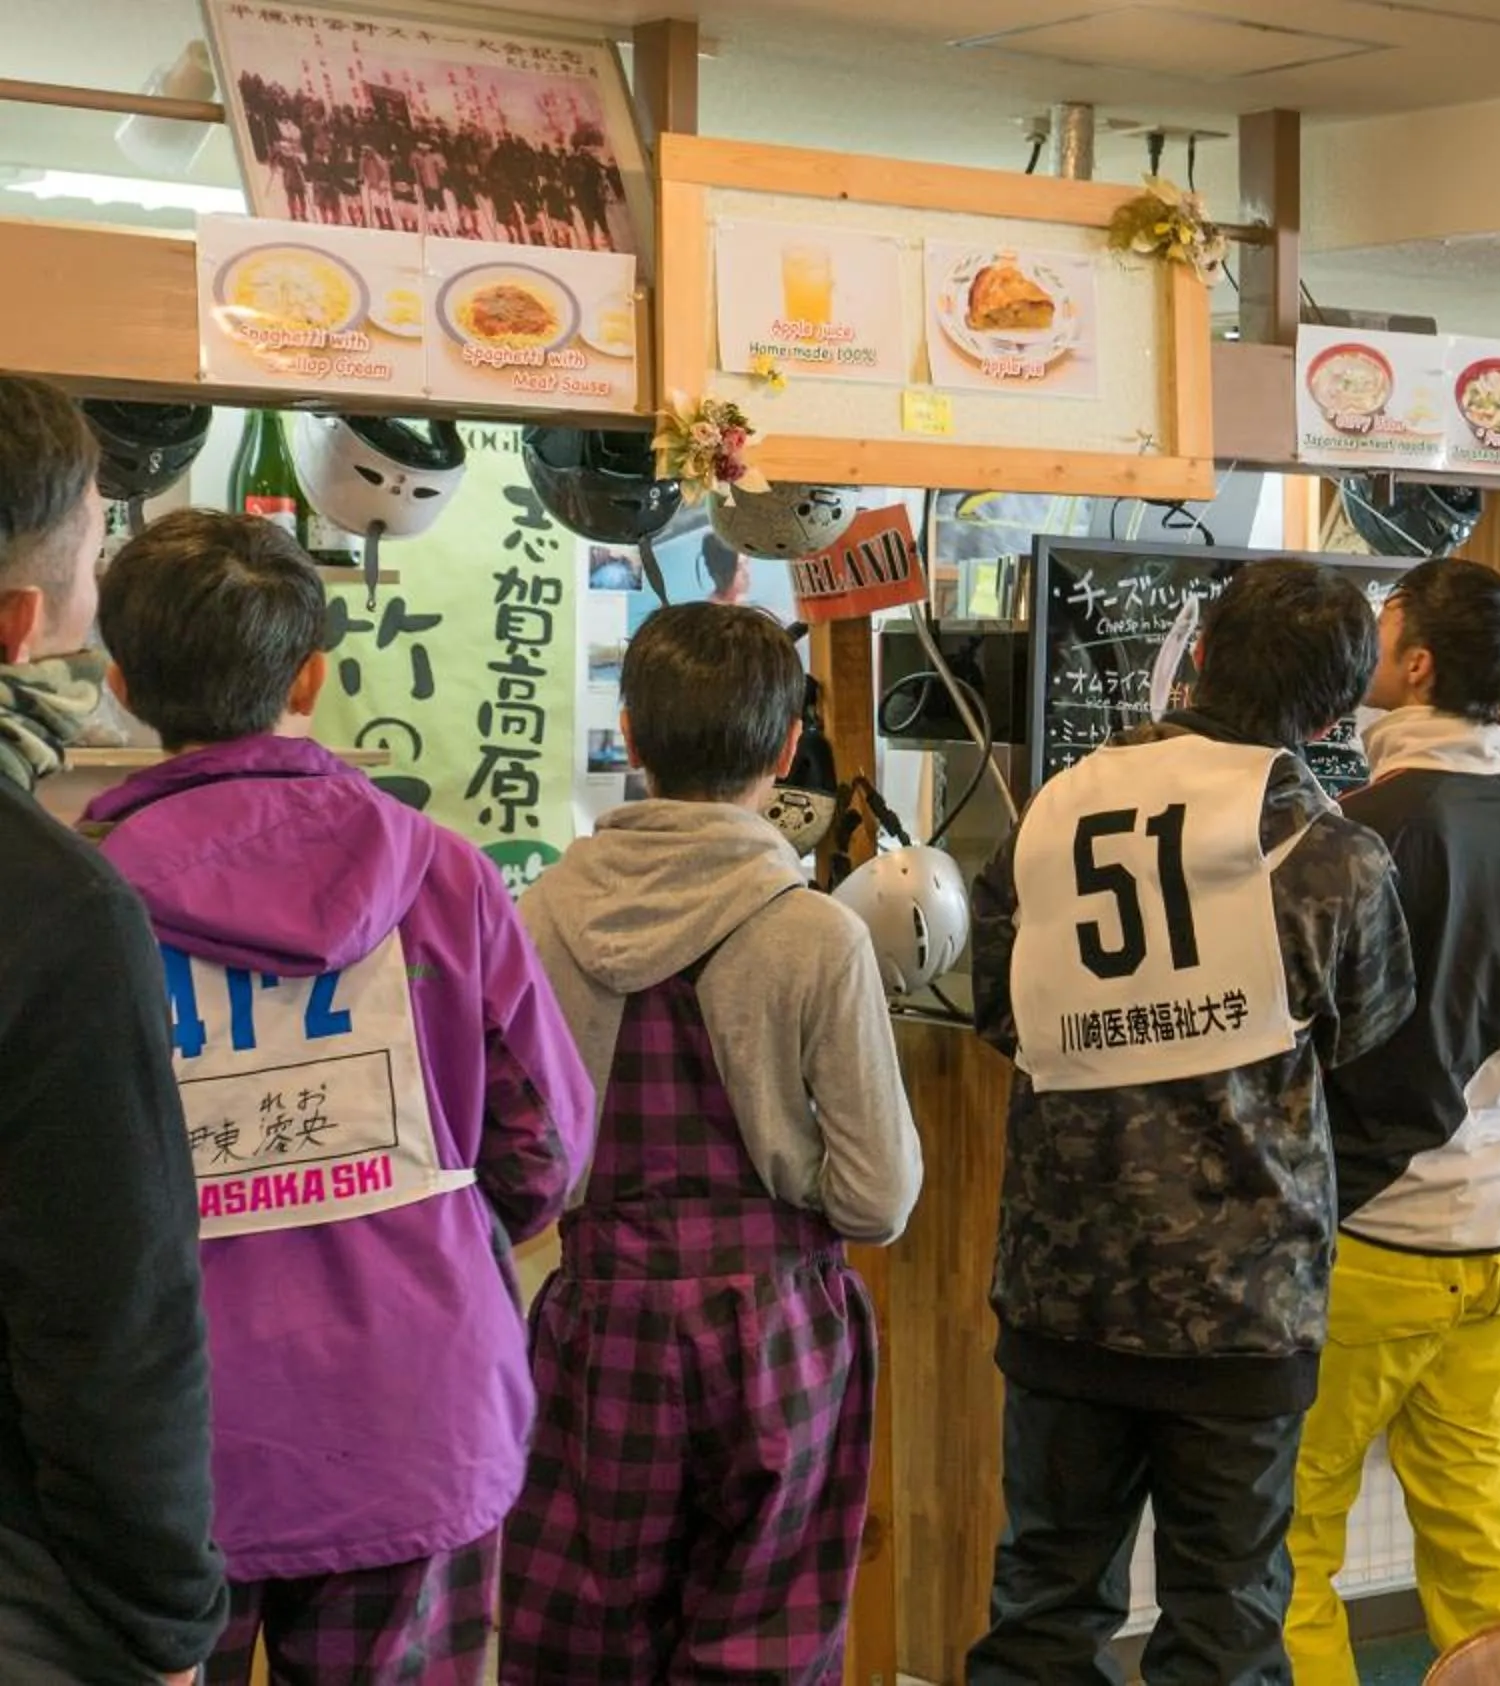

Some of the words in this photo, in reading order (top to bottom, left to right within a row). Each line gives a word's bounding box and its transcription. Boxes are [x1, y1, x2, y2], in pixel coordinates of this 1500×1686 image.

[329, 331, 370, 350] with
[770, 319, 813, 341] Apple
[333, 358, 390, 379] Cream
[463, 342, 545, 368] Spaghetti
[547, 349, 587, 369] with
[982, 358, 1021, 378] Apple
[512, 371, 557, 391] Meat
[464, 484, 562, 834] 志賀高原
[1066, 667, 1151, 695] オムライス
[1073, 803, 1200, 980] 51
[1060, 989, 1249, 1054] 川崎医療福祉大学
[332, 1155, 393, 1199] SKI
